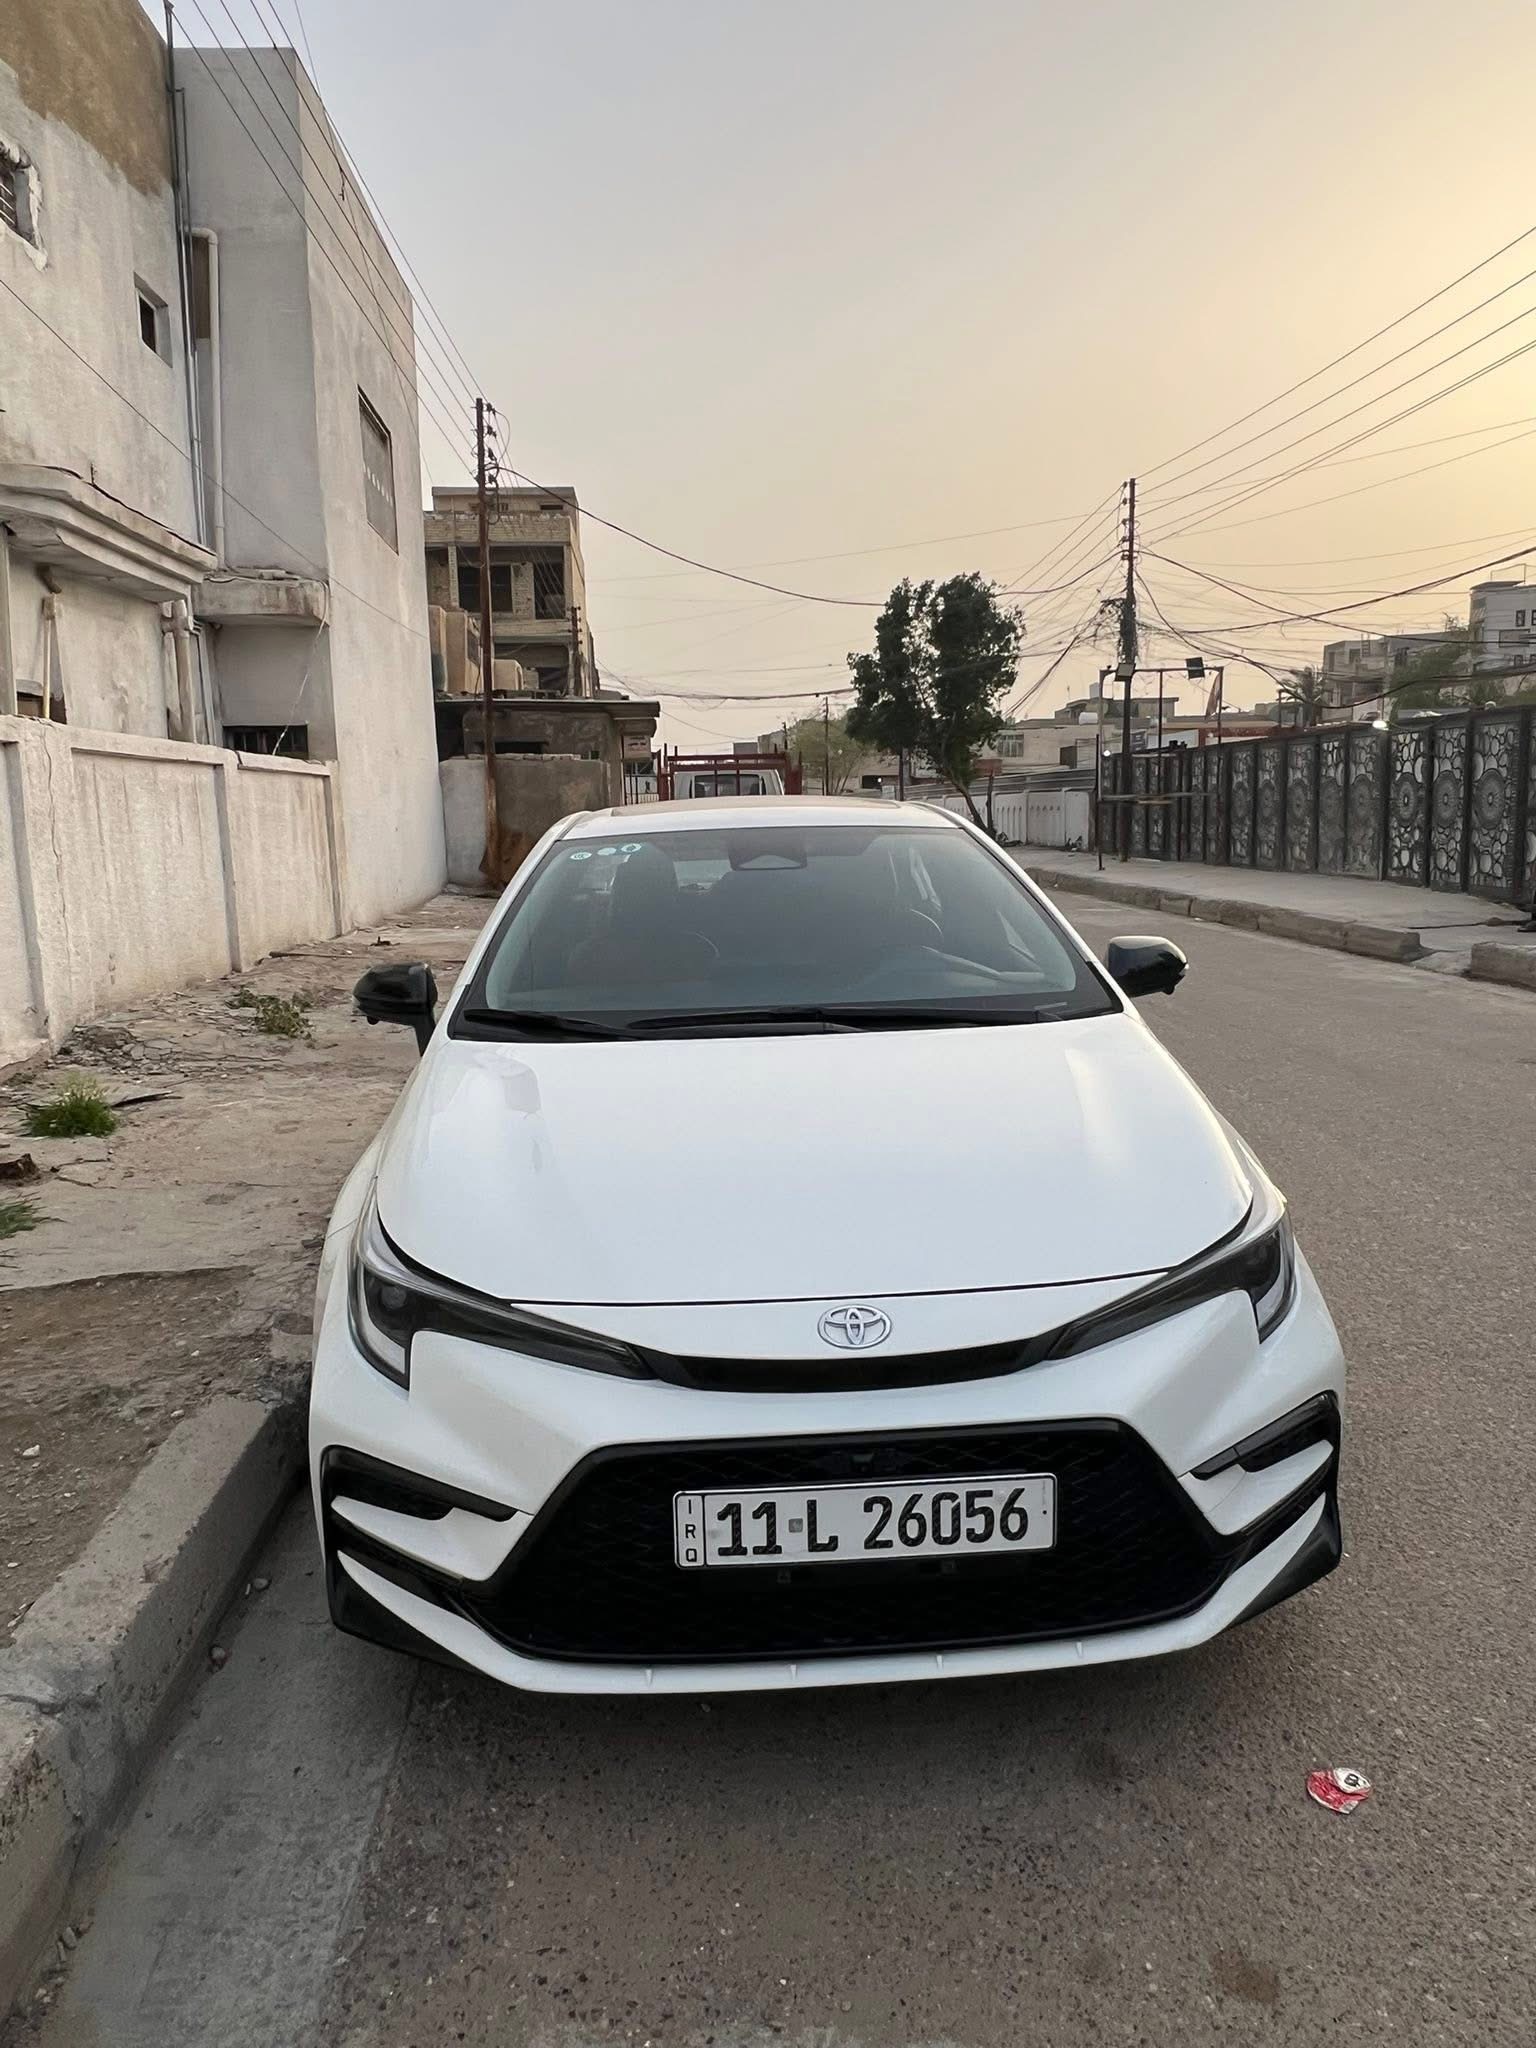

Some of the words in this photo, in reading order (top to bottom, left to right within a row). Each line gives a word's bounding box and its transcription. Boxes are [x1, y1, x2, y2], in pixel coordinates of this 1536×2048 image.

[685, 1499, 698, 1563] IRQ
[716, 1501, 783, 1556] 11
[806, 1499, 839, 1553] L
[862, 1487, 1029, 1550] 26056
